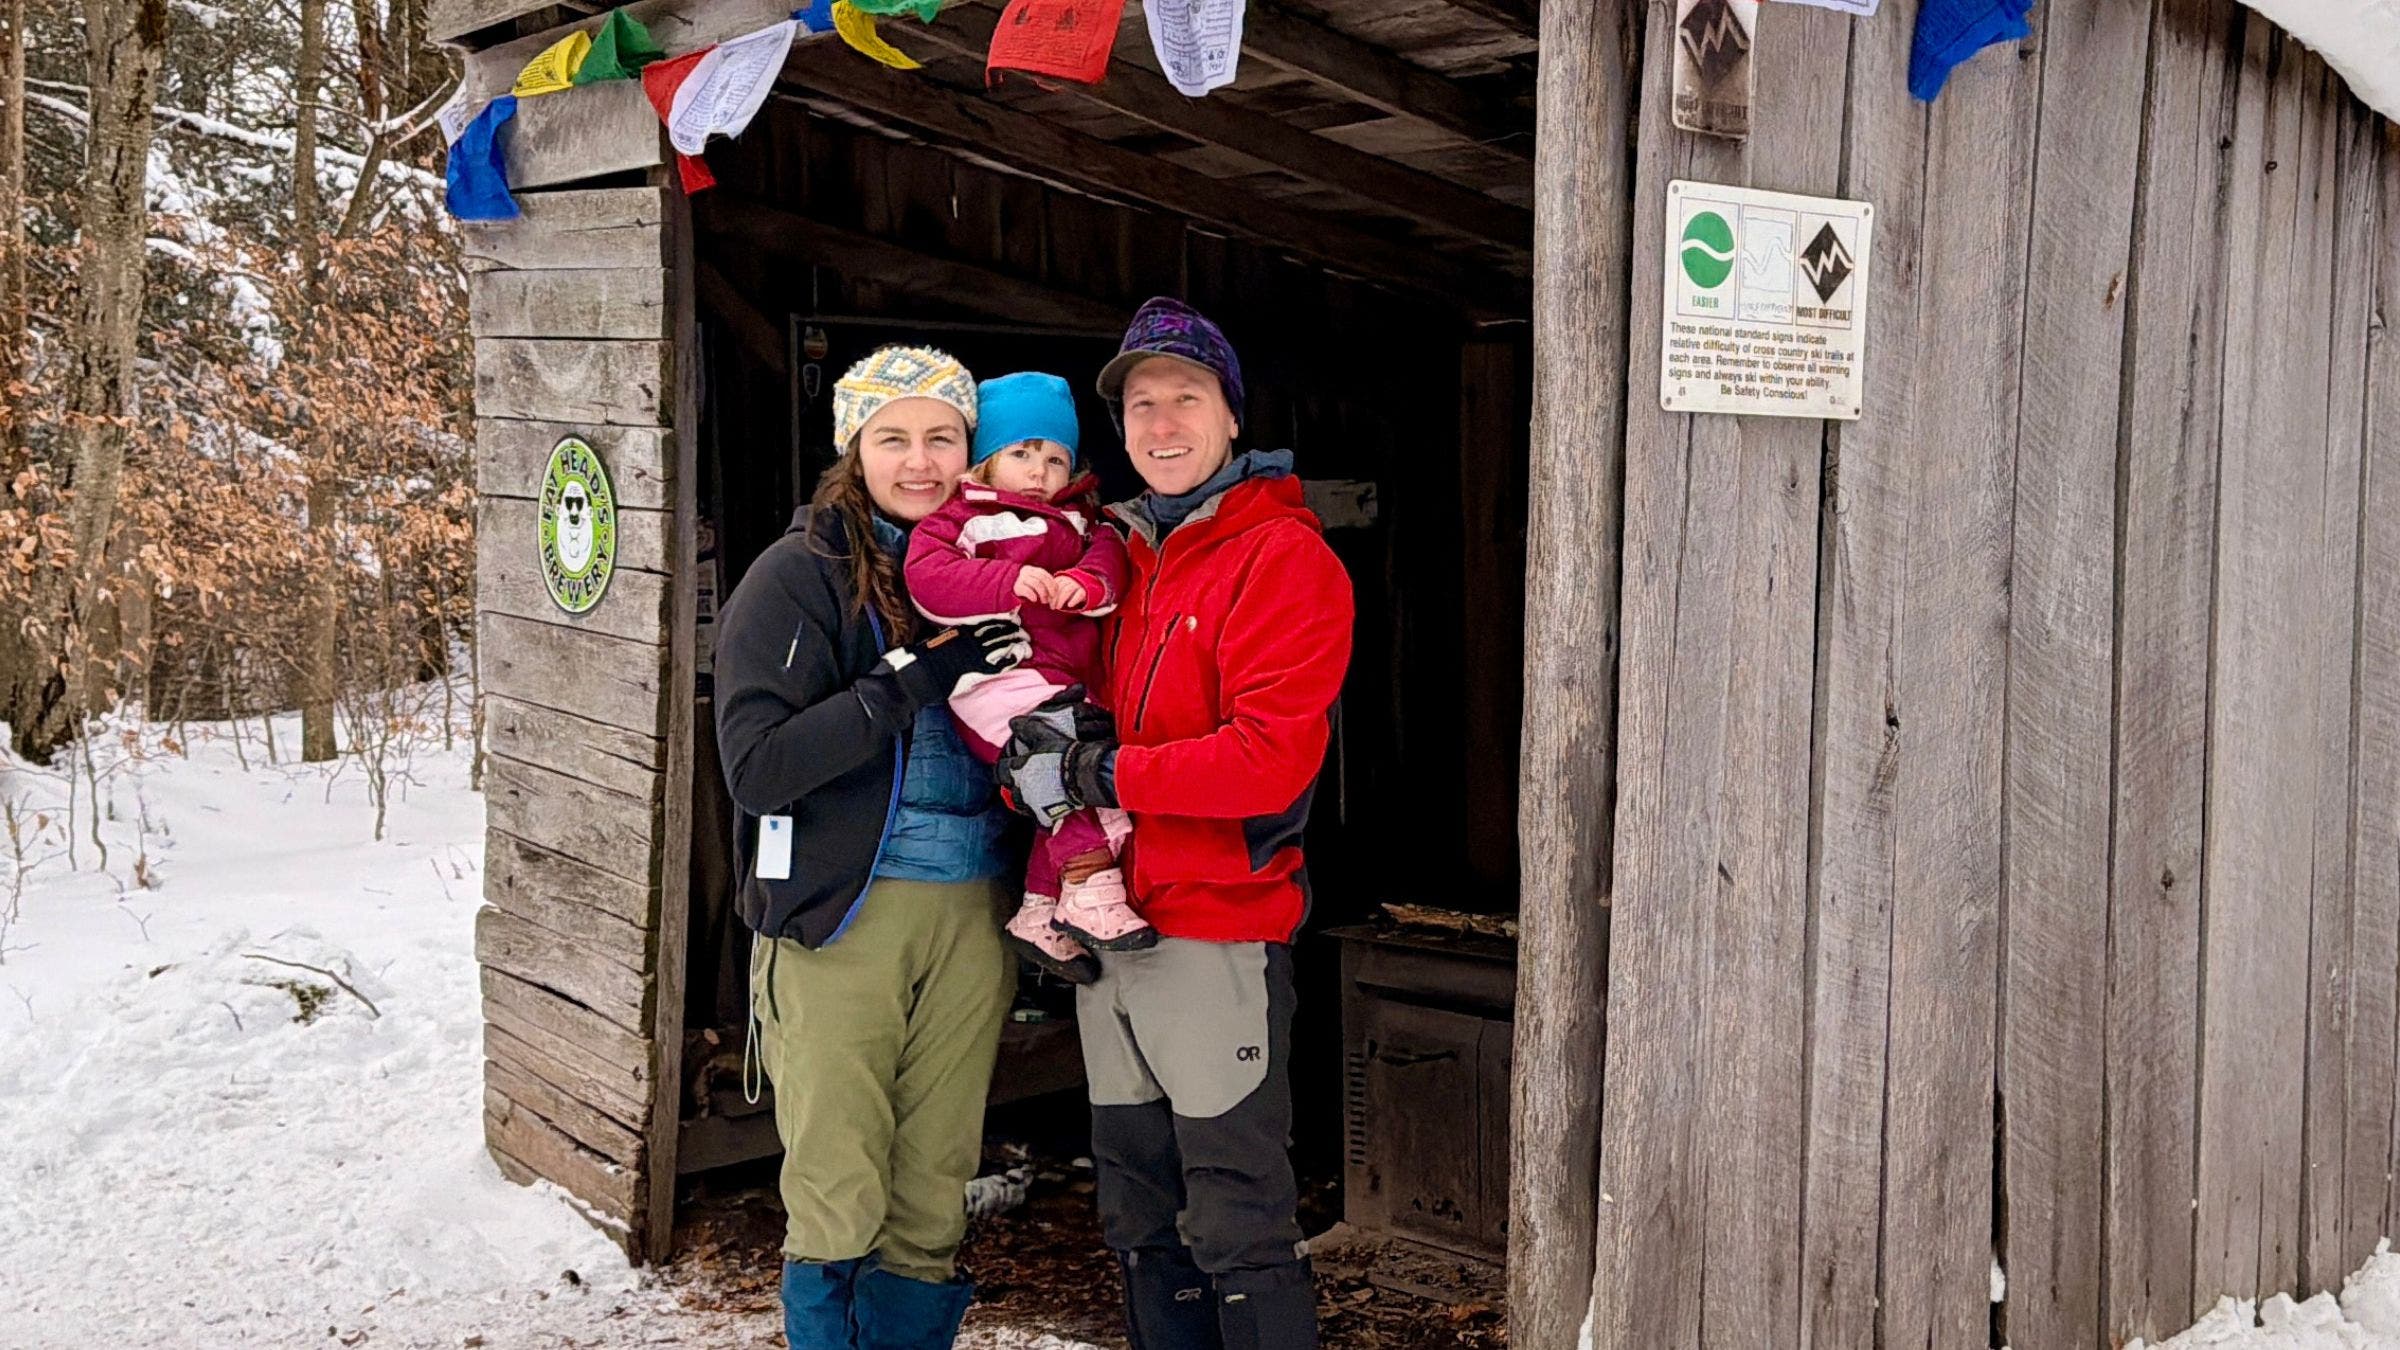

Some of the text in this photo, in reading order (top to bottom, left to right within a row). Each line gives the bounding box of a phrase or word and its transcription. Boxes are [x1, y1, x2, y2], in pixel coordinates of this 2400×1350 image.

[1692, 295, 1719, 309] EASIER
[1797, 305, 1817, 318] MOST
[1818, 307, 1852, 321] DIFFICULT
[1671, 322, 1827, 345] These national standard signs indicate
[1670, 337, 1855, 361] relative difficulty of cross country ski trails at
[1669, 353, 1850, 378] each area. Remember to observe all warning
[1668, 366, 1831, 390] signs and always ski within your ability.
[1720, 384, 1808, 400] Be Safety Conscious!
[543, 545, 609, 602] BREWERY
[1236, 1046, 1260, 1062] OR
